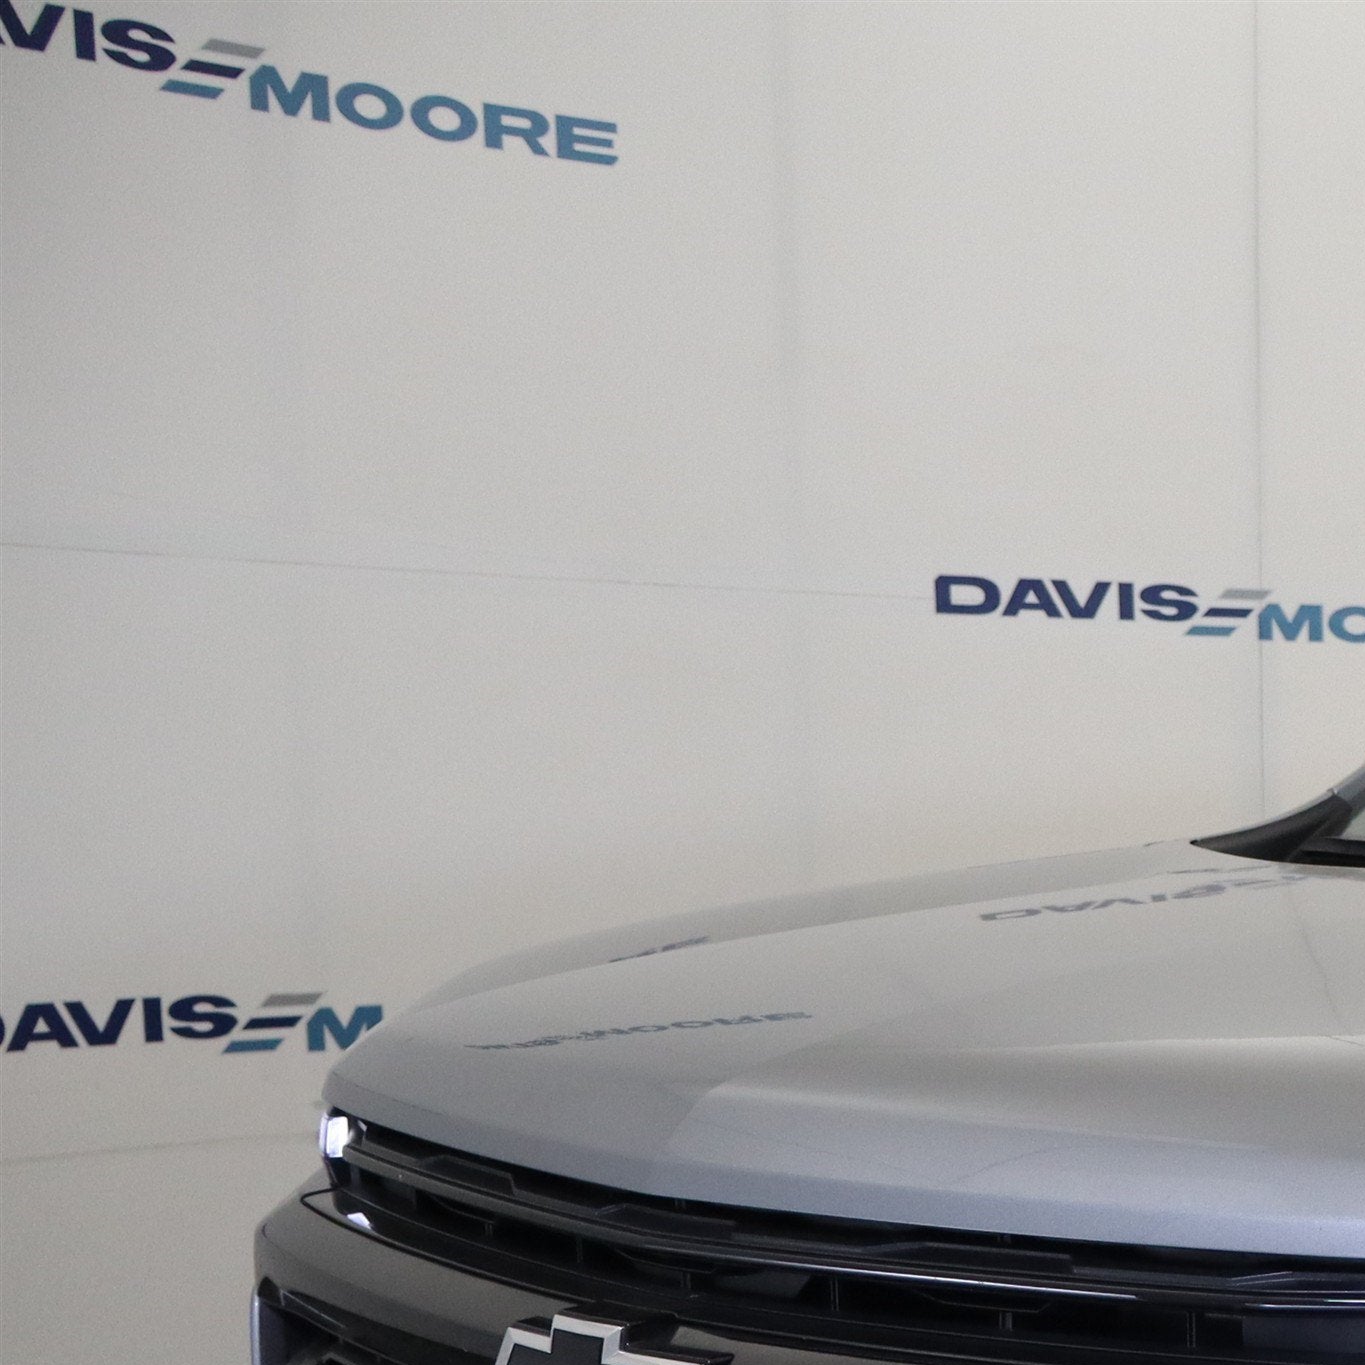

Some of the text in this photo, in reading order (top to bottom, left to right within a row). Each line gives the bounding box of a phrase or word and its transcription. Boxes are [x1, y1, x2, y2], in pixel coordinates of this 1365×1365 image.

[0, 0, 618, 166] VIS MOORE
[934, 575, 1200, 622] DAVIS
[0, 994, 238, 1053] AVIS
